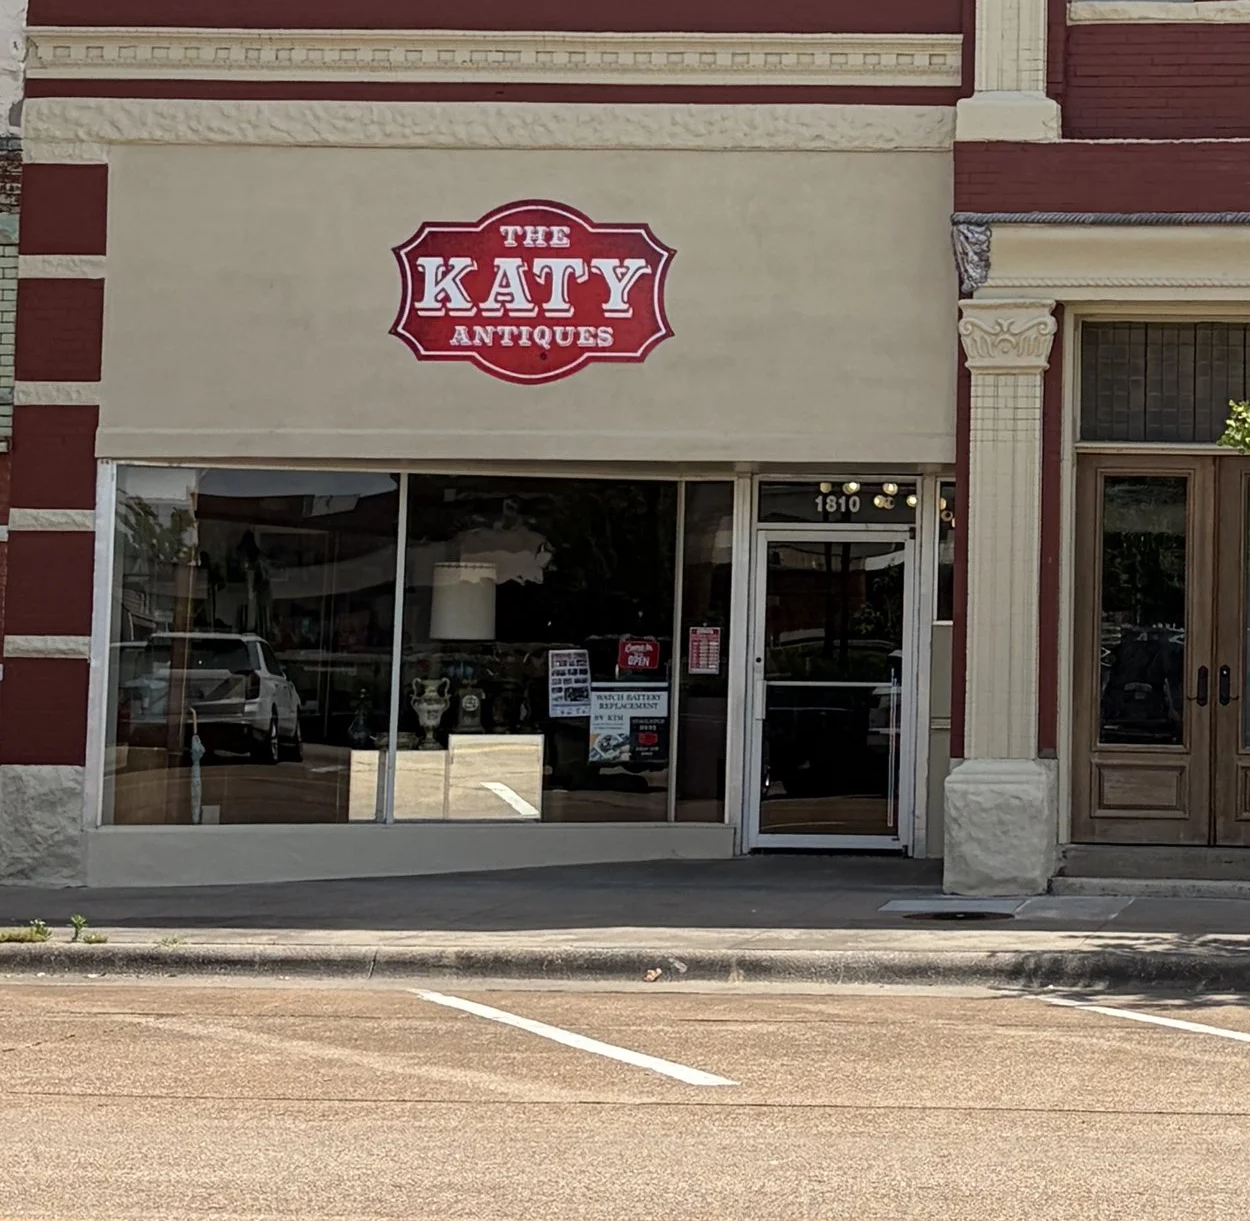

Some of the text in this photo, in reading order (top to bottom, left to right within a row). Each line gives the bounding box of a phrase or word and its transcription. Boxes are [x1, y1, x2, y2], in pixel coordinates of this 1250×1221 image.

[500, 226, 571, 247] THE
[414, 257, 652, 318] KATY
[449, 326, 614, 349] ANTIQUES
[815, 495, 861, 513] 1810
[627, 655, 650, 666] OPEN
